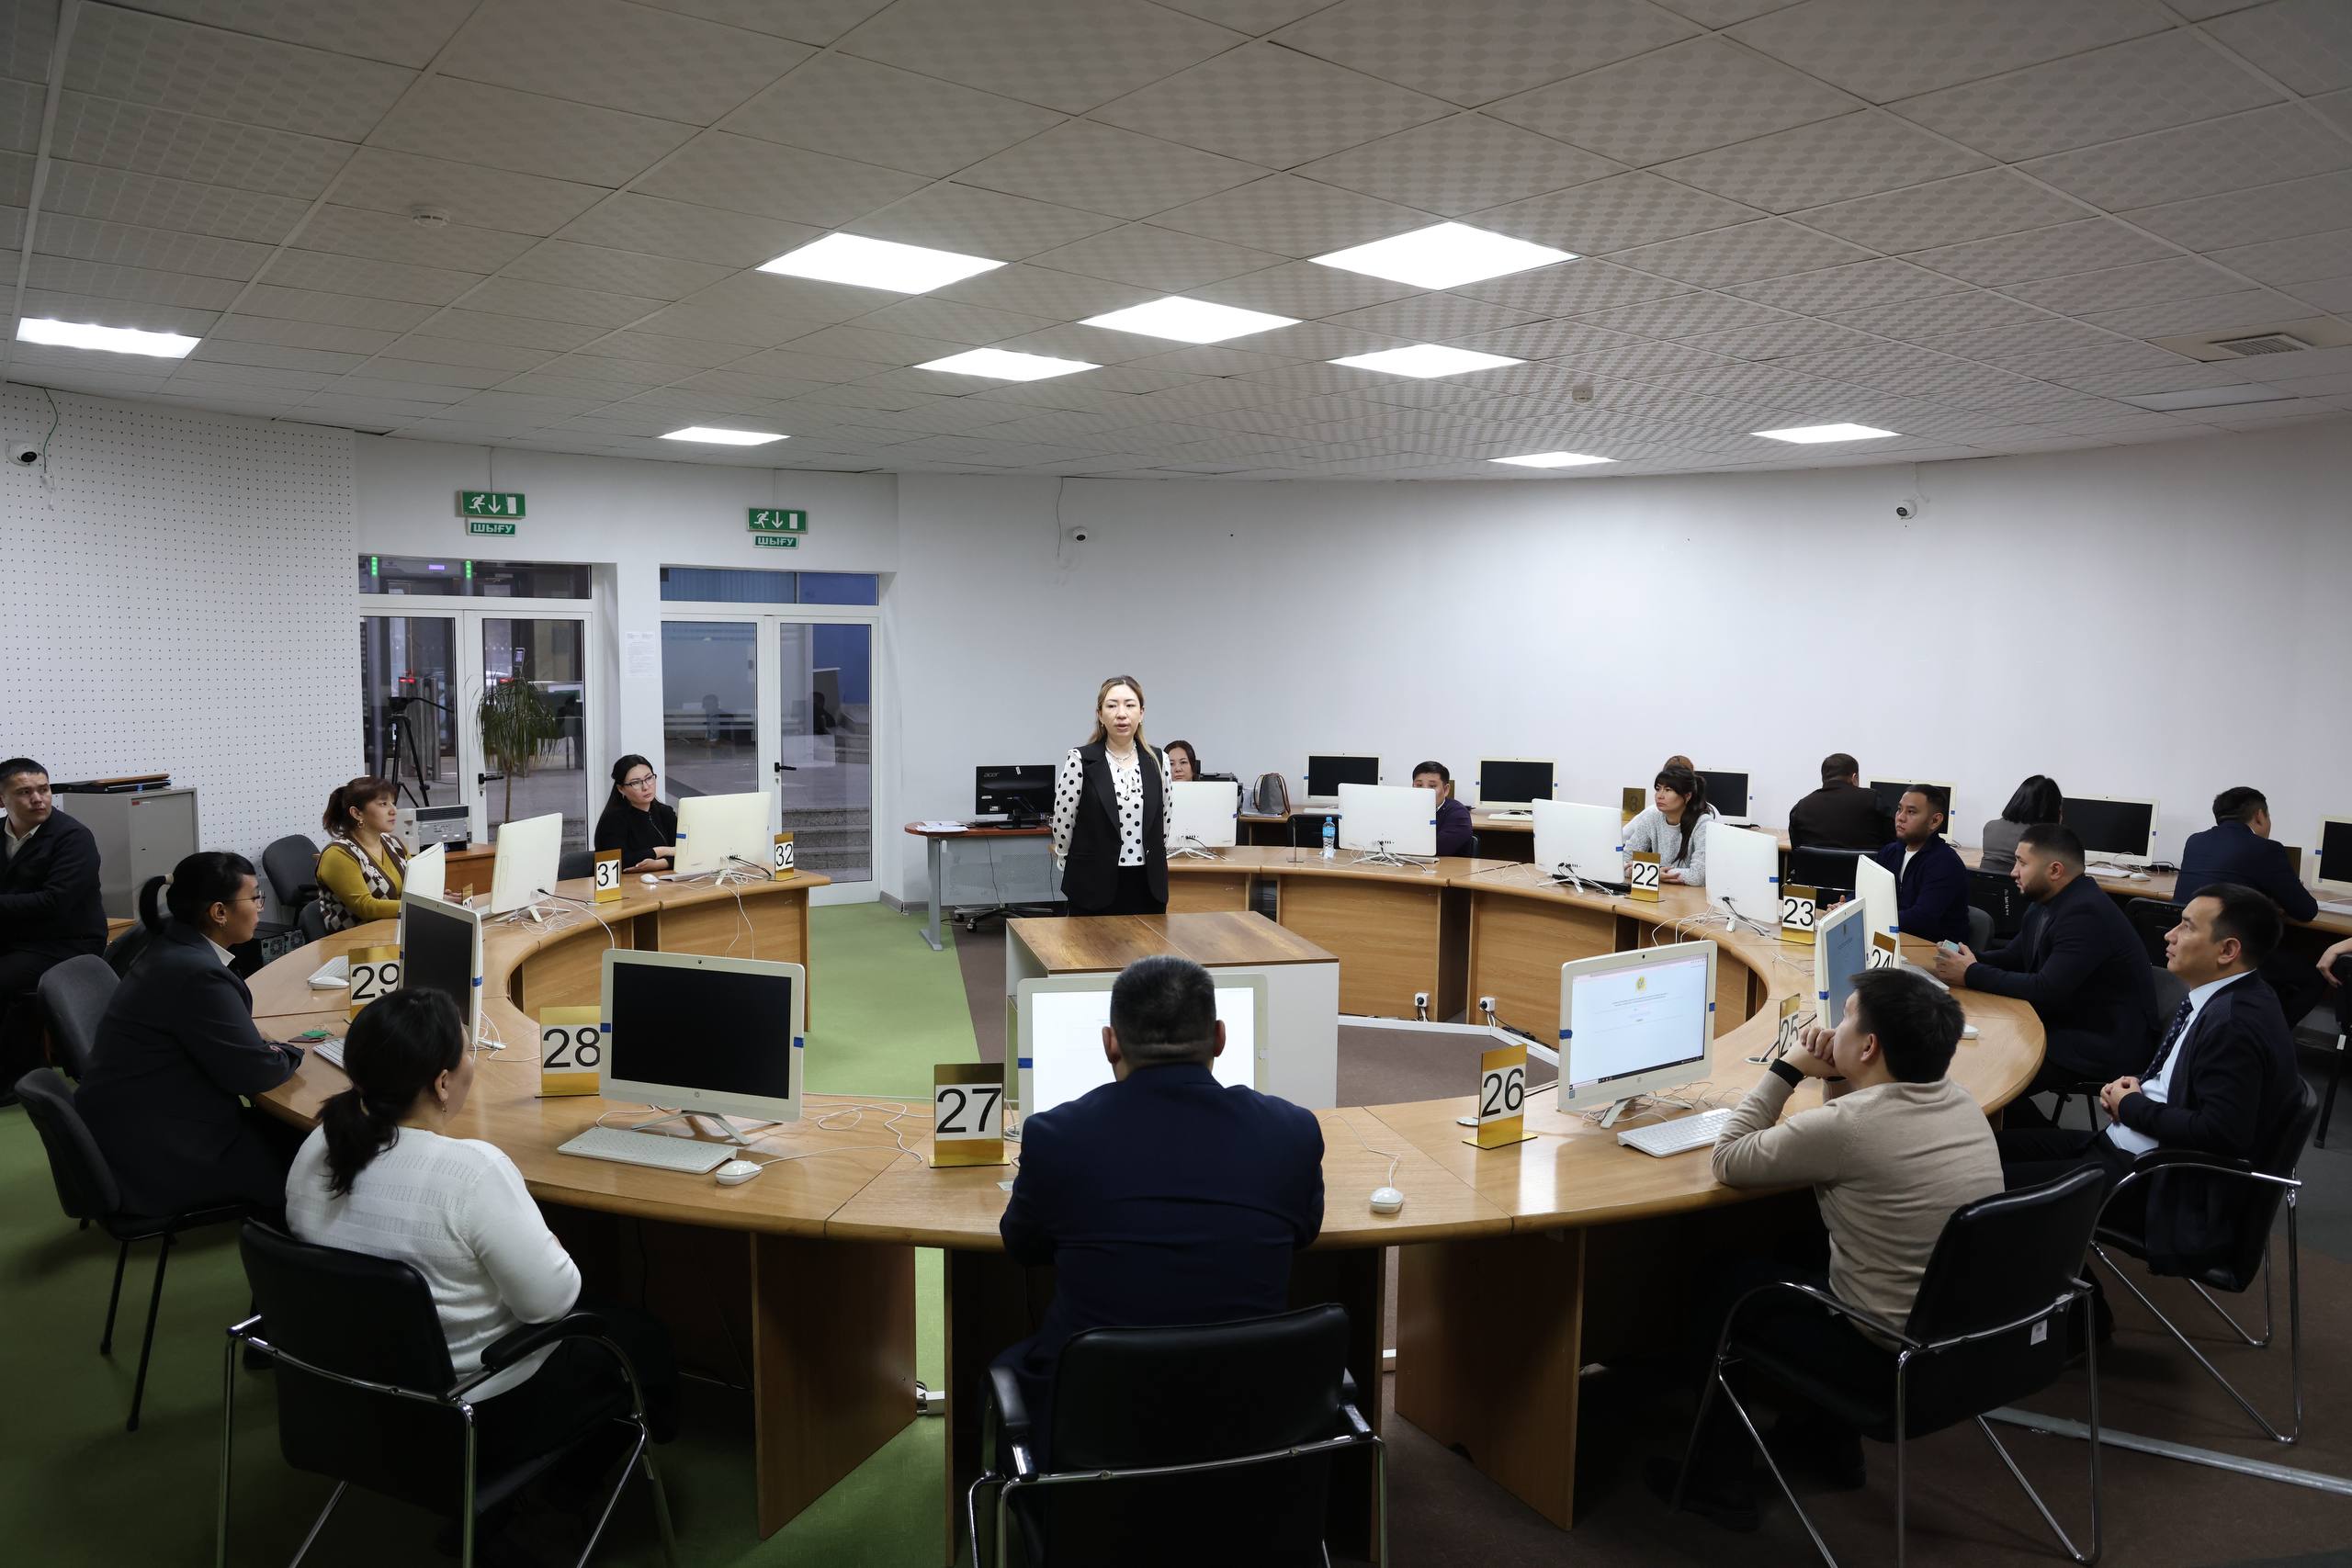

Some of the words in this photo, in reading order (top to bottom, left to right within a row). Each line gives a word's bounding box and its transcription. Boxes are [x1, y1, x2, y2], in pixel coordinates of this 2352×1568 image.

[775, 843, 794, 867] 32
[597, 861, 619, 887] 31
[1632, 863, 1659, 888] 22
[1782, 897, 1815, 927] 23
[352, 963, 400, 1000] 29
[543, 1027, 601, 1069] 28
[1780, 1013, 1799, 1058] 25
[936, 1087, 1002, 1134] 27
[1480, 1067, 1525, 1118] 26
